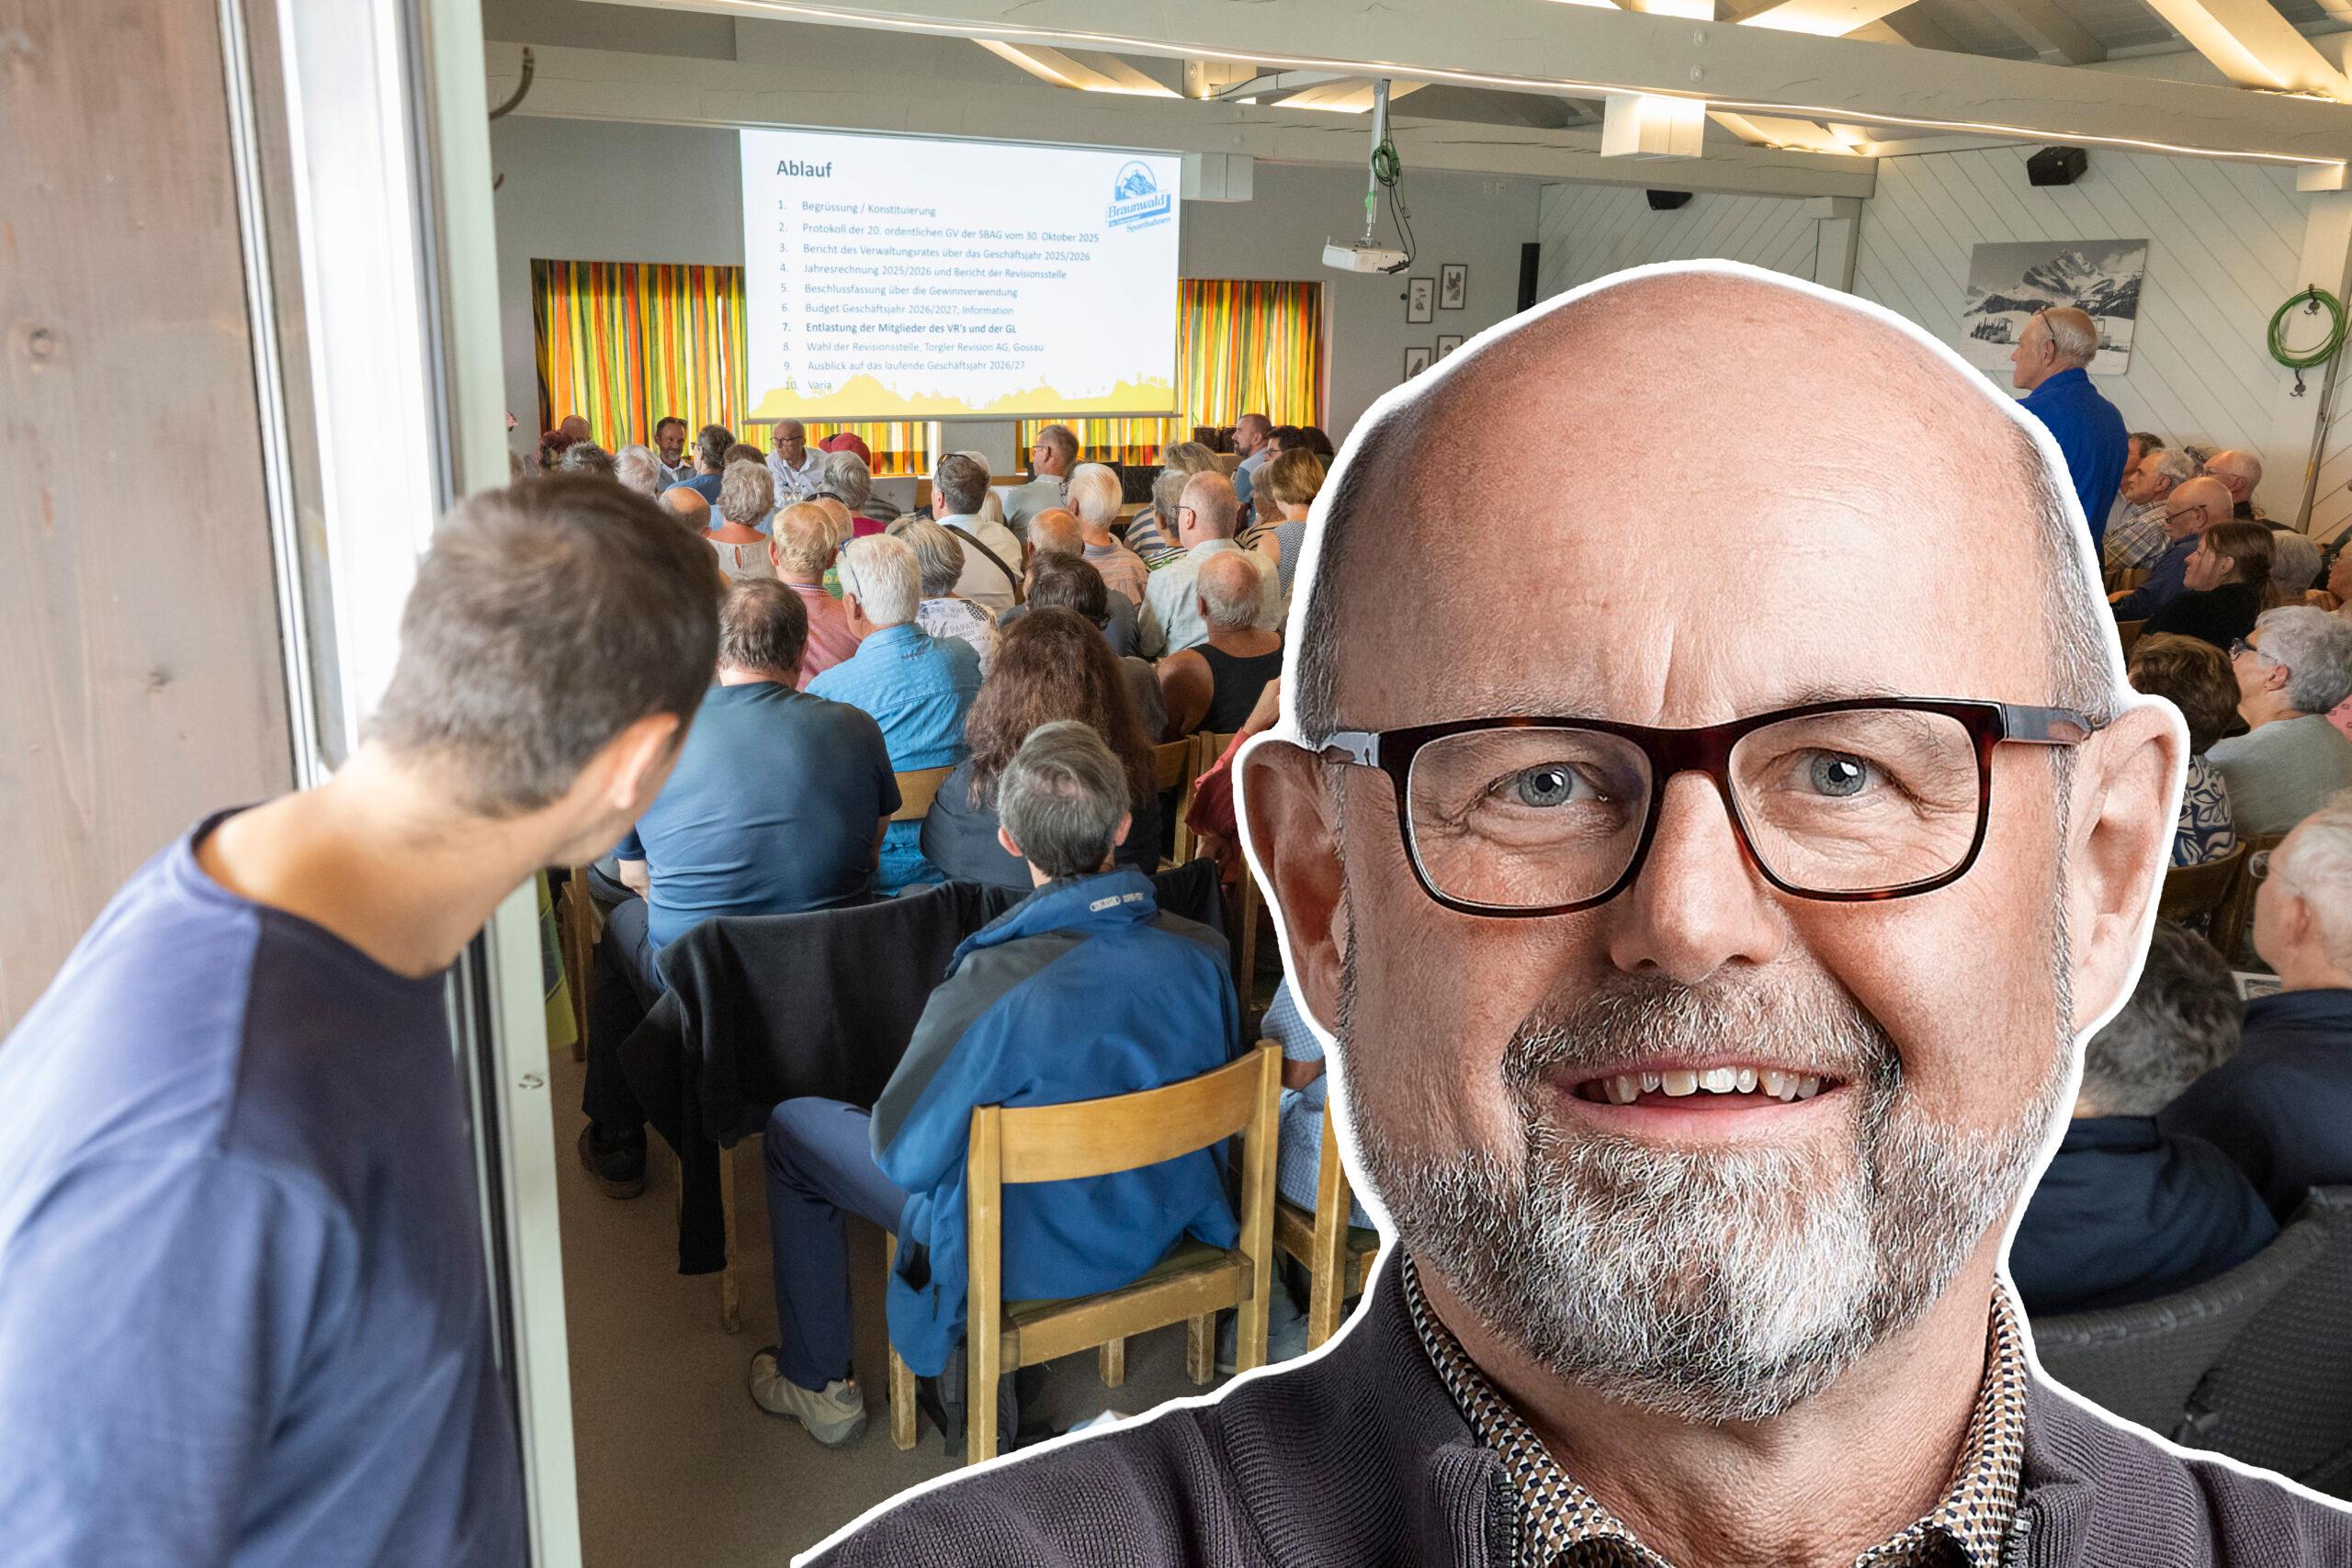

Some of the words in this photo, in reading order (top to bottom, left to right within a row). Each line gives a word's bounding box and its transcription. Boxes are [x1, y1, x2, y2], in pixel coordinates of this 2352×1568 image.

[776, 160, 832, 178] Ablauf
[778, 200, 787, 210] 1.
[802, 201, 858, 214] Begrüssung
[868, 205, 936, 218] Konstituierung
[1108, 194, 1166, 219] Braunwald
[1126, 216, 1171, 232] Sportbahnen
[778, 222, 787, 232] 2.
[803, 223, 846, 233] Protokoll
[849, 225, 865, 234] der
[885, 227, 943, 237] ordentlichen
[945, 229, 958, 237] GV
[961, 229, 976, 238] der
[978, 230, 1002, 239] SBAG
[1042, 231, 1076, 242] Oktober
[1079, 233, 1099, 243] 2025
[779, 243, 788, 254] 3.
[804, 243, 836, 254] Bericht
[840, 245, 857, 255] des
[860, 246, 940, 258] Verwaltungsrates
[943, 247, 964, 258] über
[966, 249, 981, 258] das
[983, 250, 1042, 261] Geschäftsjahr
[1045, 252, 1091, 262] 2025/2026
[780, 263, 789, 273] 4.
[804, 264, 879, 276] Jahresrechnung
[882, 265, 932, 276] 2025/2026
[934, 267, 952, 276] und
[955, 267, 985, 276] Bericht
[988, 268, 1003, 277] der
[1005, 269, 1067, 279] Revisionsstelle
[781, 283, 790, 293] 5.
[805, 284, 886, 296] Beschlussfassung
[889, 285, 910, 296] über
[912, 287, 926, 295] die
[929, 286, 1017, 299] Gewinnverwendung
[782, 303, 790, 312] 6.
[806, 303, 840, 314] Budget
[842, 304, 905, 315] Geschäftsjahr
[909, 304, 960, 316] 2026/2027,
[963, 306, 1013, 315] Information
[783, 322, 792, 333] 7.
[806, 322, 858, 334] Entlastung
[860, 323, 876, 333] der
[878, 323, 926, 334] Mitglieder
[929, 323, 945, 333] des
[969, 324, 986, 333] und
[988, 324, 1003, 333] der
[1005, 324, 1017, 333] GL
[784, 342, 792, 351] 8.
[807, 342, 831, 351] Wahl
[834, 343, 849, 351] der
[853, 343, 922, 353] Revisionsstelle,
[925, 343, 955, 353] Torgler
[958, 343, 992, 351] Revision
[996, 343, 1012, 353] AG,
[1013, 343, 1044, 352] Gossau
[784, 362, 793, 371] 9.
[808, 361, 846, 370] Ausblick
[849, 361, 864, 370] auf
[866, 362, 882, 370] das
[885, 361, 925, 370] laufende
[927, 360, 986, 371] Geschäftsjahr
[989, 361, 1024, 370] 2026/27
[786, 381, 799, 390] 10.
[808, 380, 831, 390] Varia
